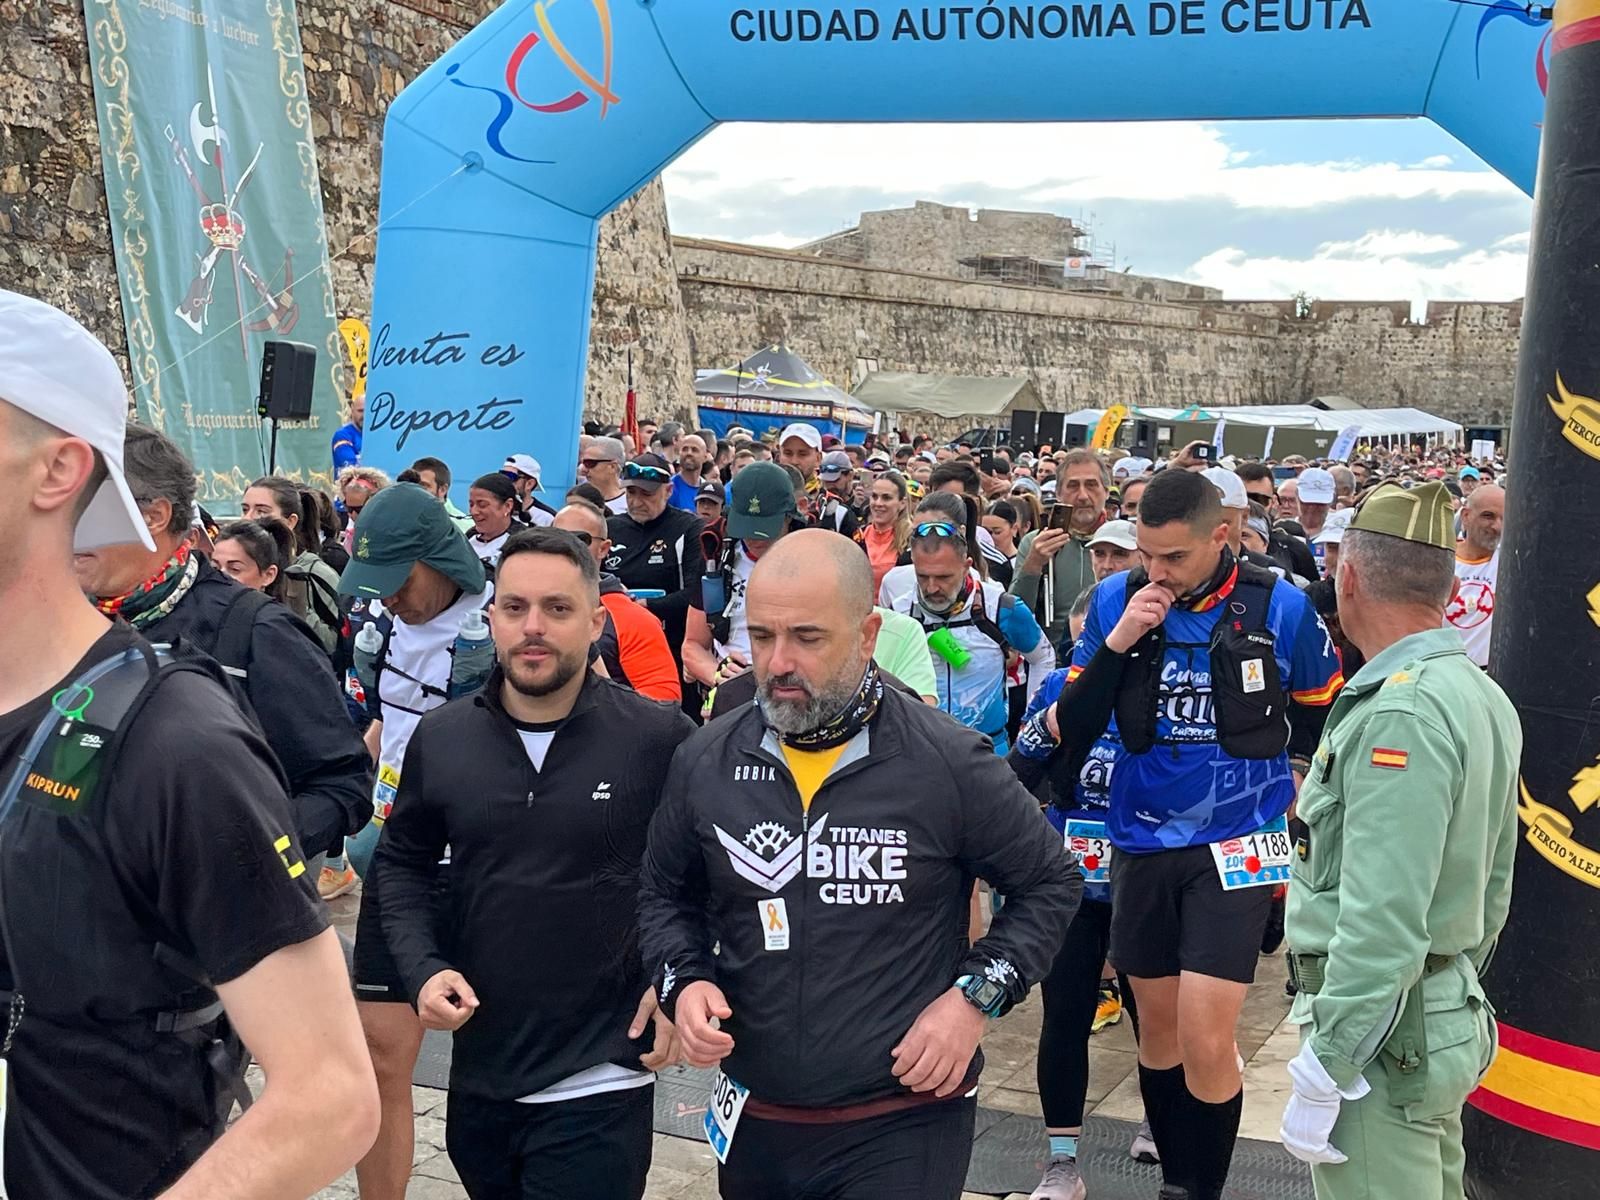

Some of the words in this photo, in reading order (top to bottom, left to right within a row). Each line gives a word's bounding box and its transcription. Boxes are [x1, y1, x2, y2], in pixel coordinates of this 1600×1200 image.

[730, 9, 879, 42] CIUDAD
[892, 0, 1136, 41] AUTÓNOMA
[1149, 1, 1206, 36] DE
[1221, 0, 1372, 33] CEUTA
[372, 323, 470, 370] Ceuta
[480, 344, 525, 367] es
[370, 391, 523, 451] Deporte
[1568, 416, 1600, 446] TERCIO
[25, 772, 80, 801] KIPRUN
[734, 765, 776, 781] GOBIK
[829, 826, 907, 845] TITANES
[1248, 834, 1289, 858] 1188
[1532, 824, 1567, 858] TERCIO
[806, 843, 909, 880] BIKE
[819, 883, 905, 905] CEUTA
